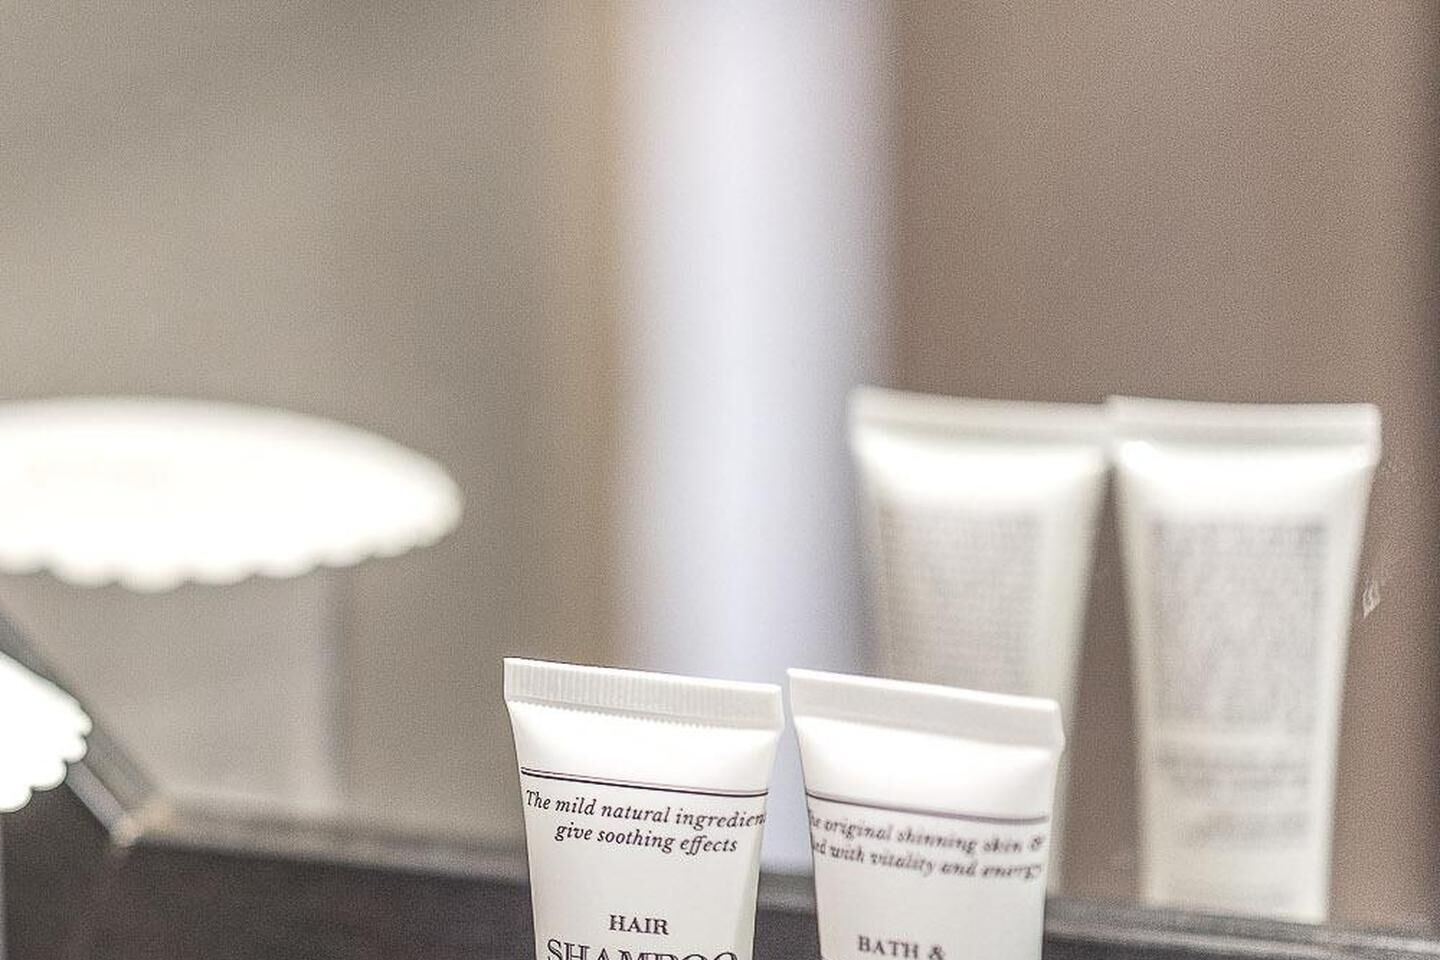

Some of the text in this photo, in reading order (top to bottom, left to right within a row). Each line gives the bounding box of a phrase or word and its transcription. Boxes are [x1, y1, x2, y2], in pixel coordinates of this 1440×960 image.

[527, 790, 765, 831] The mild natural ingredien
[555, 822, 737, 855] give soothing effects
[824, 818, 891, 841] original
[831, 844, 865, 863] with
[870, 853, 934, 876] vitality
[610, 915, 669, 935] HAIR
[858, 935, 918, 960] BATH
